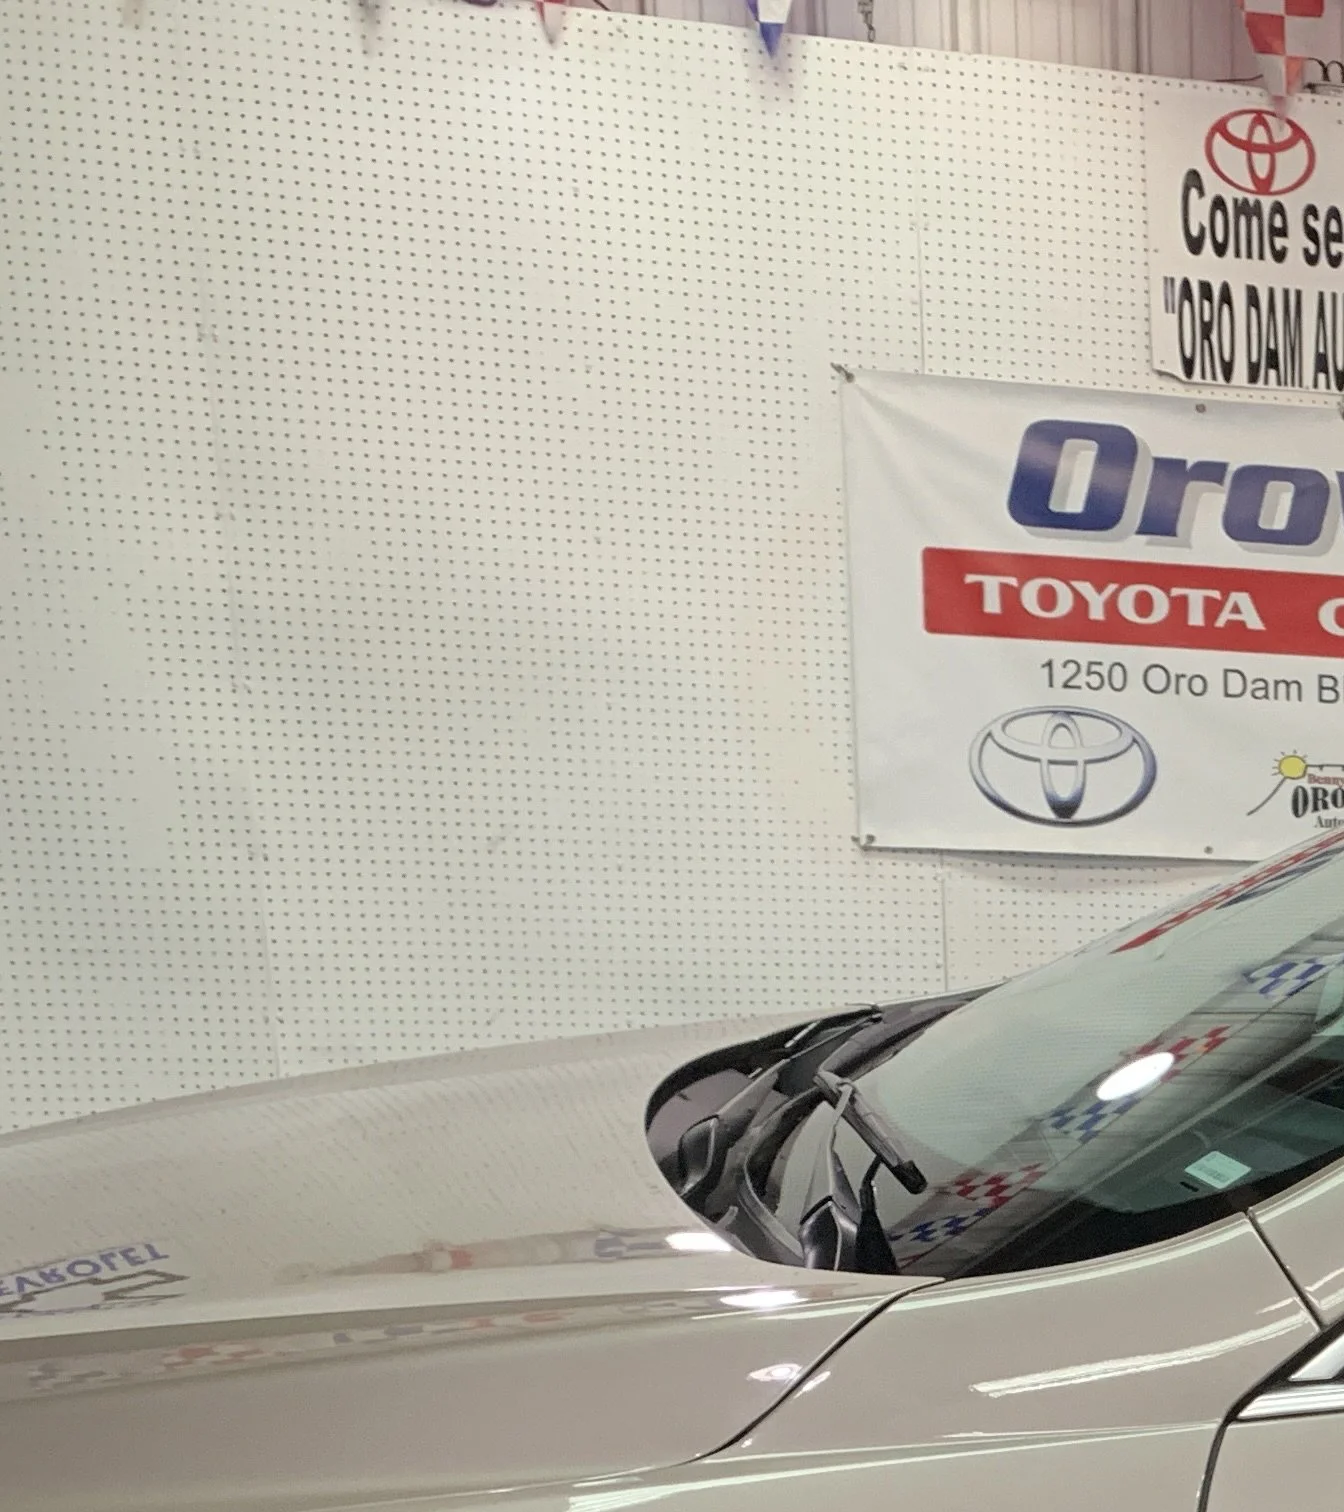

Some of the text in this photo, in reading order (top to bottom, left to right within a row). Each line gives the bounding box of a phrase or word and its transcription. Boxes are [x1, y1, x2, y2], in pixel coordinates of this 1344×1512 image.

[1181, 168, 1289, 265] Come
[1163, 276, 1236, 385] "ORO
[1245, 283, 1304, 389] DAM
[963, 573, 1267, 631] TOYOTA
[1040, 658, 1129, 693] 1250
[1142, 662, 1209, 698] Oro
[1222, 668, 1303, 703] Dam
